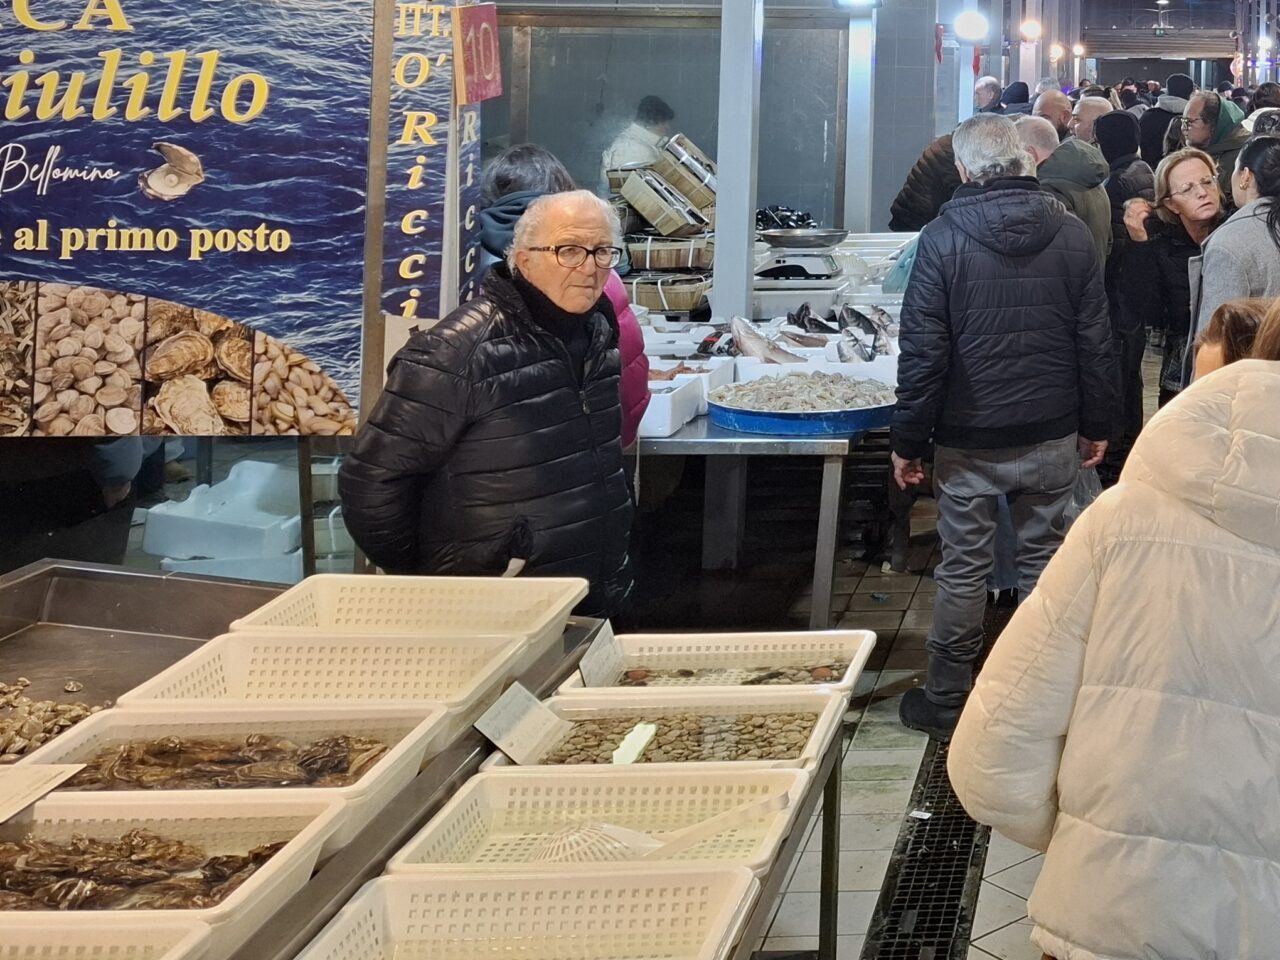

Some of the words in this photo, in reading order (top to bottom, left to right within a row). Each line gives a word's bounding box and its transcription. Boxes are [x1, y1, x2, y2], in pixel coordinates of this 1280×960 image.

[466, 22, 495, 83] 10
[1, 48, 270, 125] iulillo
[13, 219, 49, 251] al
[59, 219, 178, 260] primo
[189, 222, 291, 261] posto
